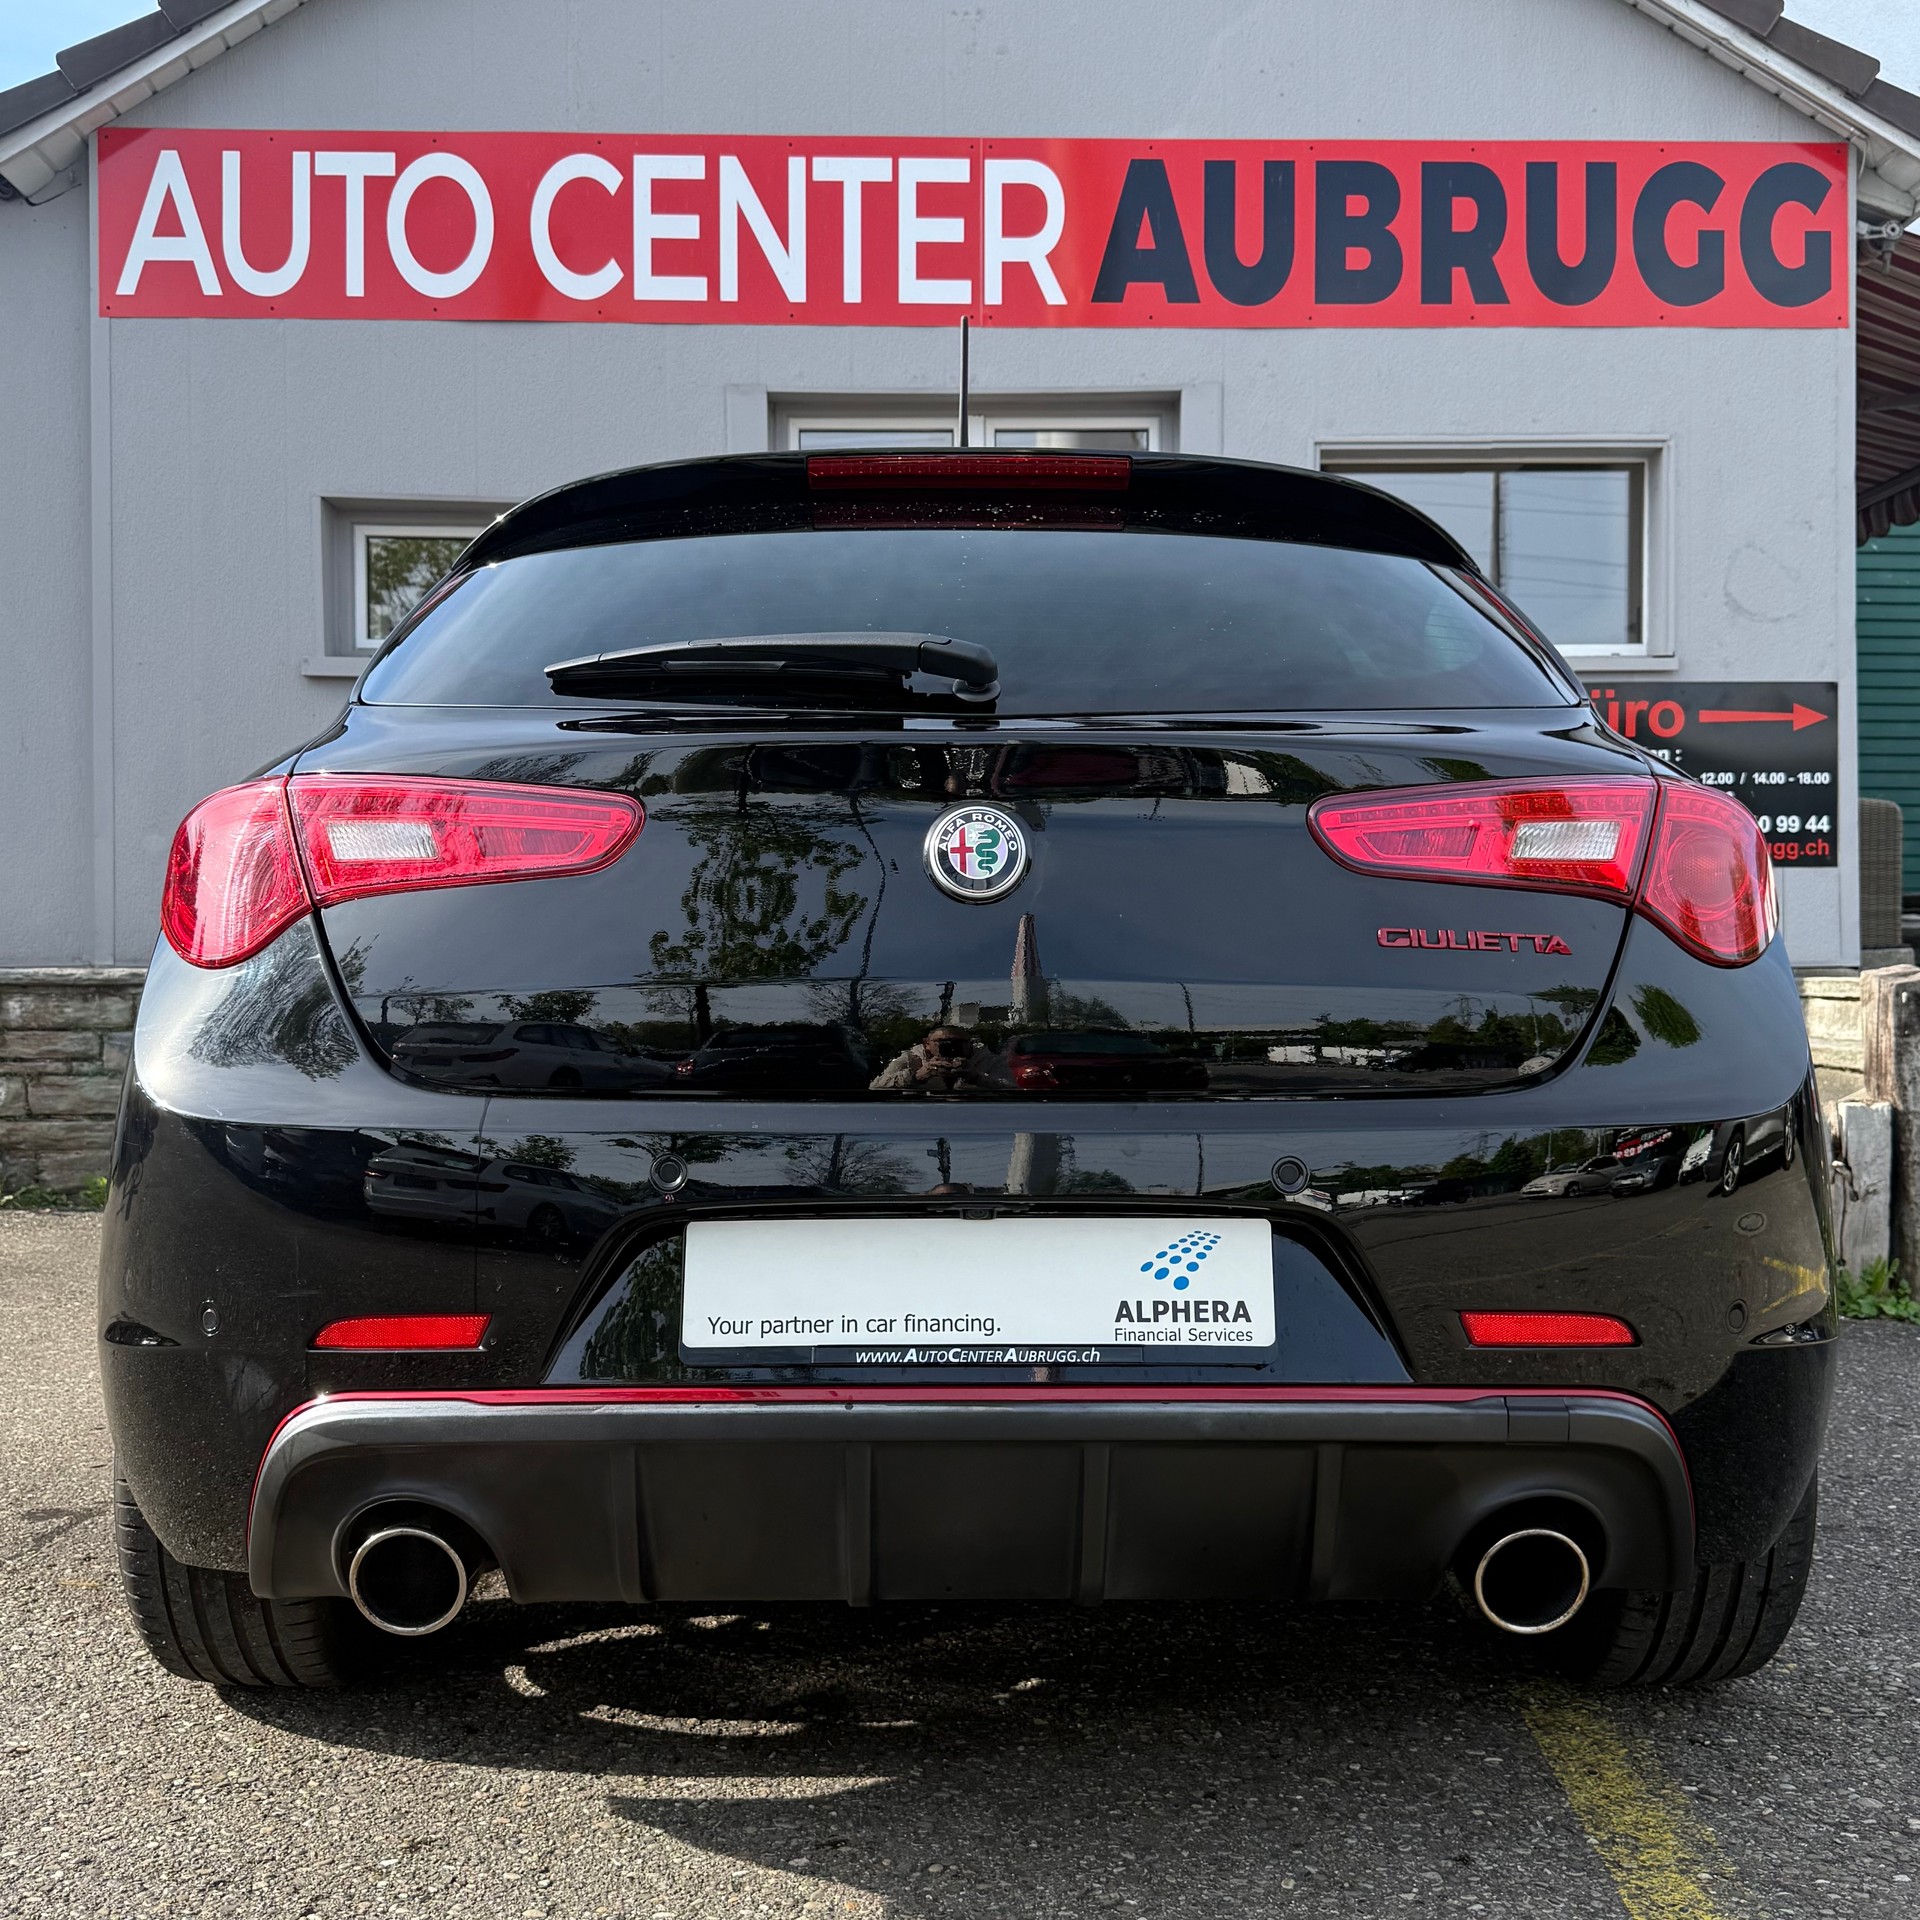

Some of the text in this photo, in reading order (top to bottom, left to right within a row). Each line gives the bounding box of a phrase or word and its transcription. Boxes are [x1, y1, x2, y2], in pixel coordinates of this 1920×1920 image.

[115, 150, 1833, 307] AUTO CENTER AUBRUGG
[938, 813, 1018, 852] ALFA ROMEO
[1757, 815, 1831, 833] 0 99 44
[1377, 928, 1572, 955] GIULIETTA
[1115, 1300, 1252, 1323] ALPHERA
[708, 1314, 1001, 1338] Your partner in car financing.
[1114, 1328, 1253, 1342] Financial Services
